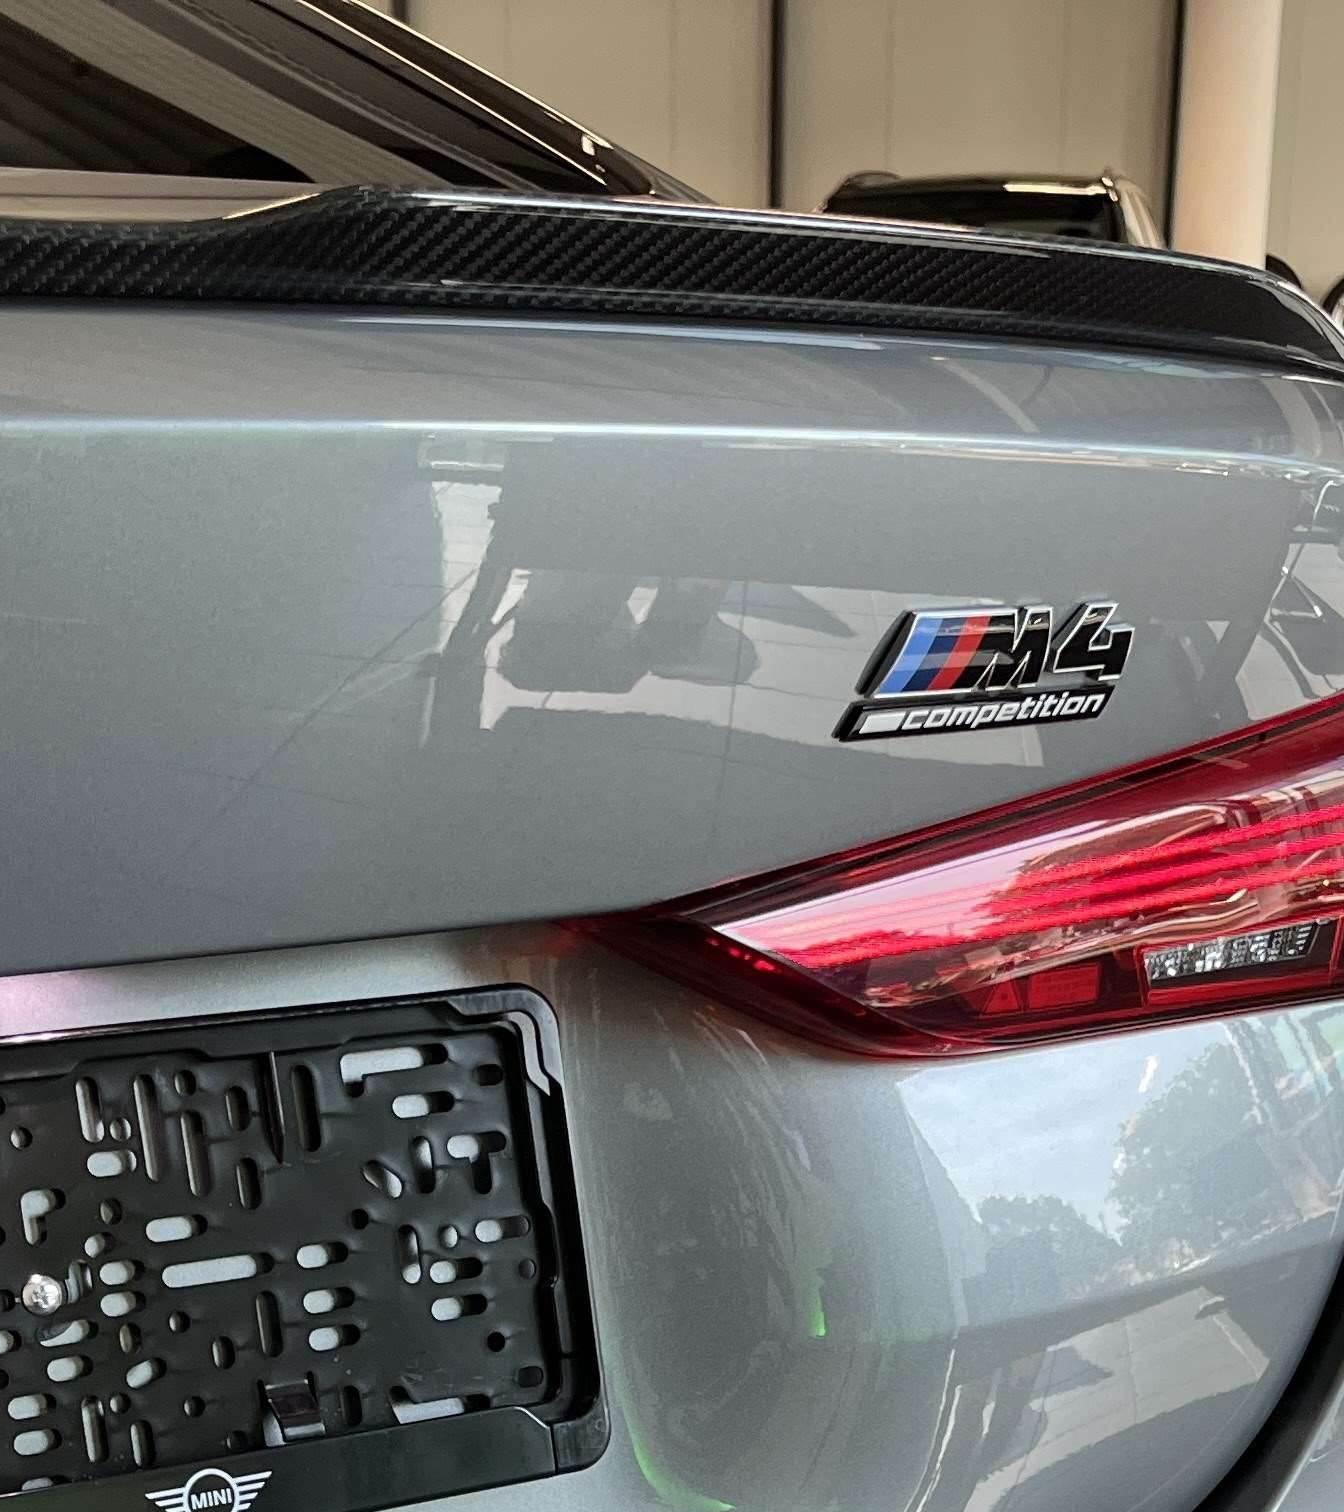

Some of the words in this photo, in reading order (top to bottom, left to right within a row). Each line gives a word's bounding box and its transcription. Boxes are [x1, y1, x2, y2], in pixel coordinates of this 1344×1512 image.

[874, 602, 1135, 698] M4
[901, 692, 1106, 731] competition
[190, 1487, 234, 1510] MINI
